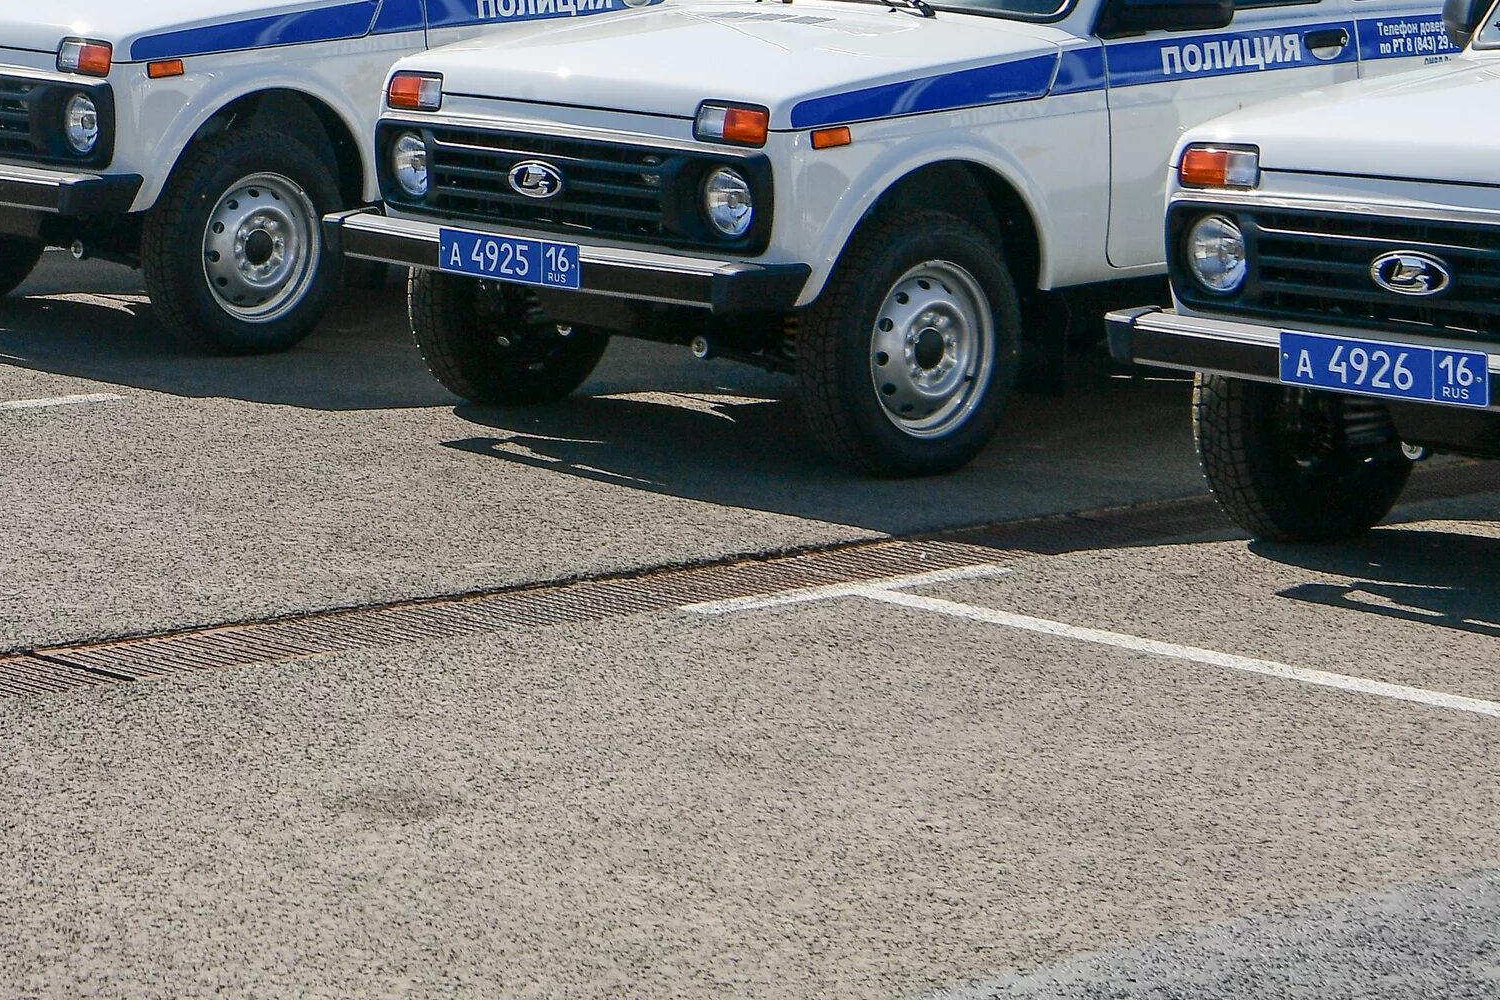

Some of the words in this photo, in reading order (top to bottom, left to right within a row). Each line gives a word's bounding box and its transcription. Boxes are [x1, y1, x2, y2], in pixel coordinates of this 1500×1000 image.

[1377, 20, 1418, 37] Телефон
[1420, 22, 1446, 35] довер
[1380, 42, 1390, 54] по
[1392, 38, 1405, 53] РТ
[1406, 39, 1412, 52] 8
[1414, 36, 1436, 54] (843)
[1161, 34, 1302, 75] ПОЛИЦИЯ
[450, 242, 462, 266] А
[471, 239, 529, 276] 4925
[546, 246, 569, 272] 16
[548, 273, 566, 283] RUS
[1296, 350, 1314, 379] А
[1328, 346, 1414, 390] 4926
[1438, 355, 1473, 386] 16
[1442, 386, 1469, 399] RUS
